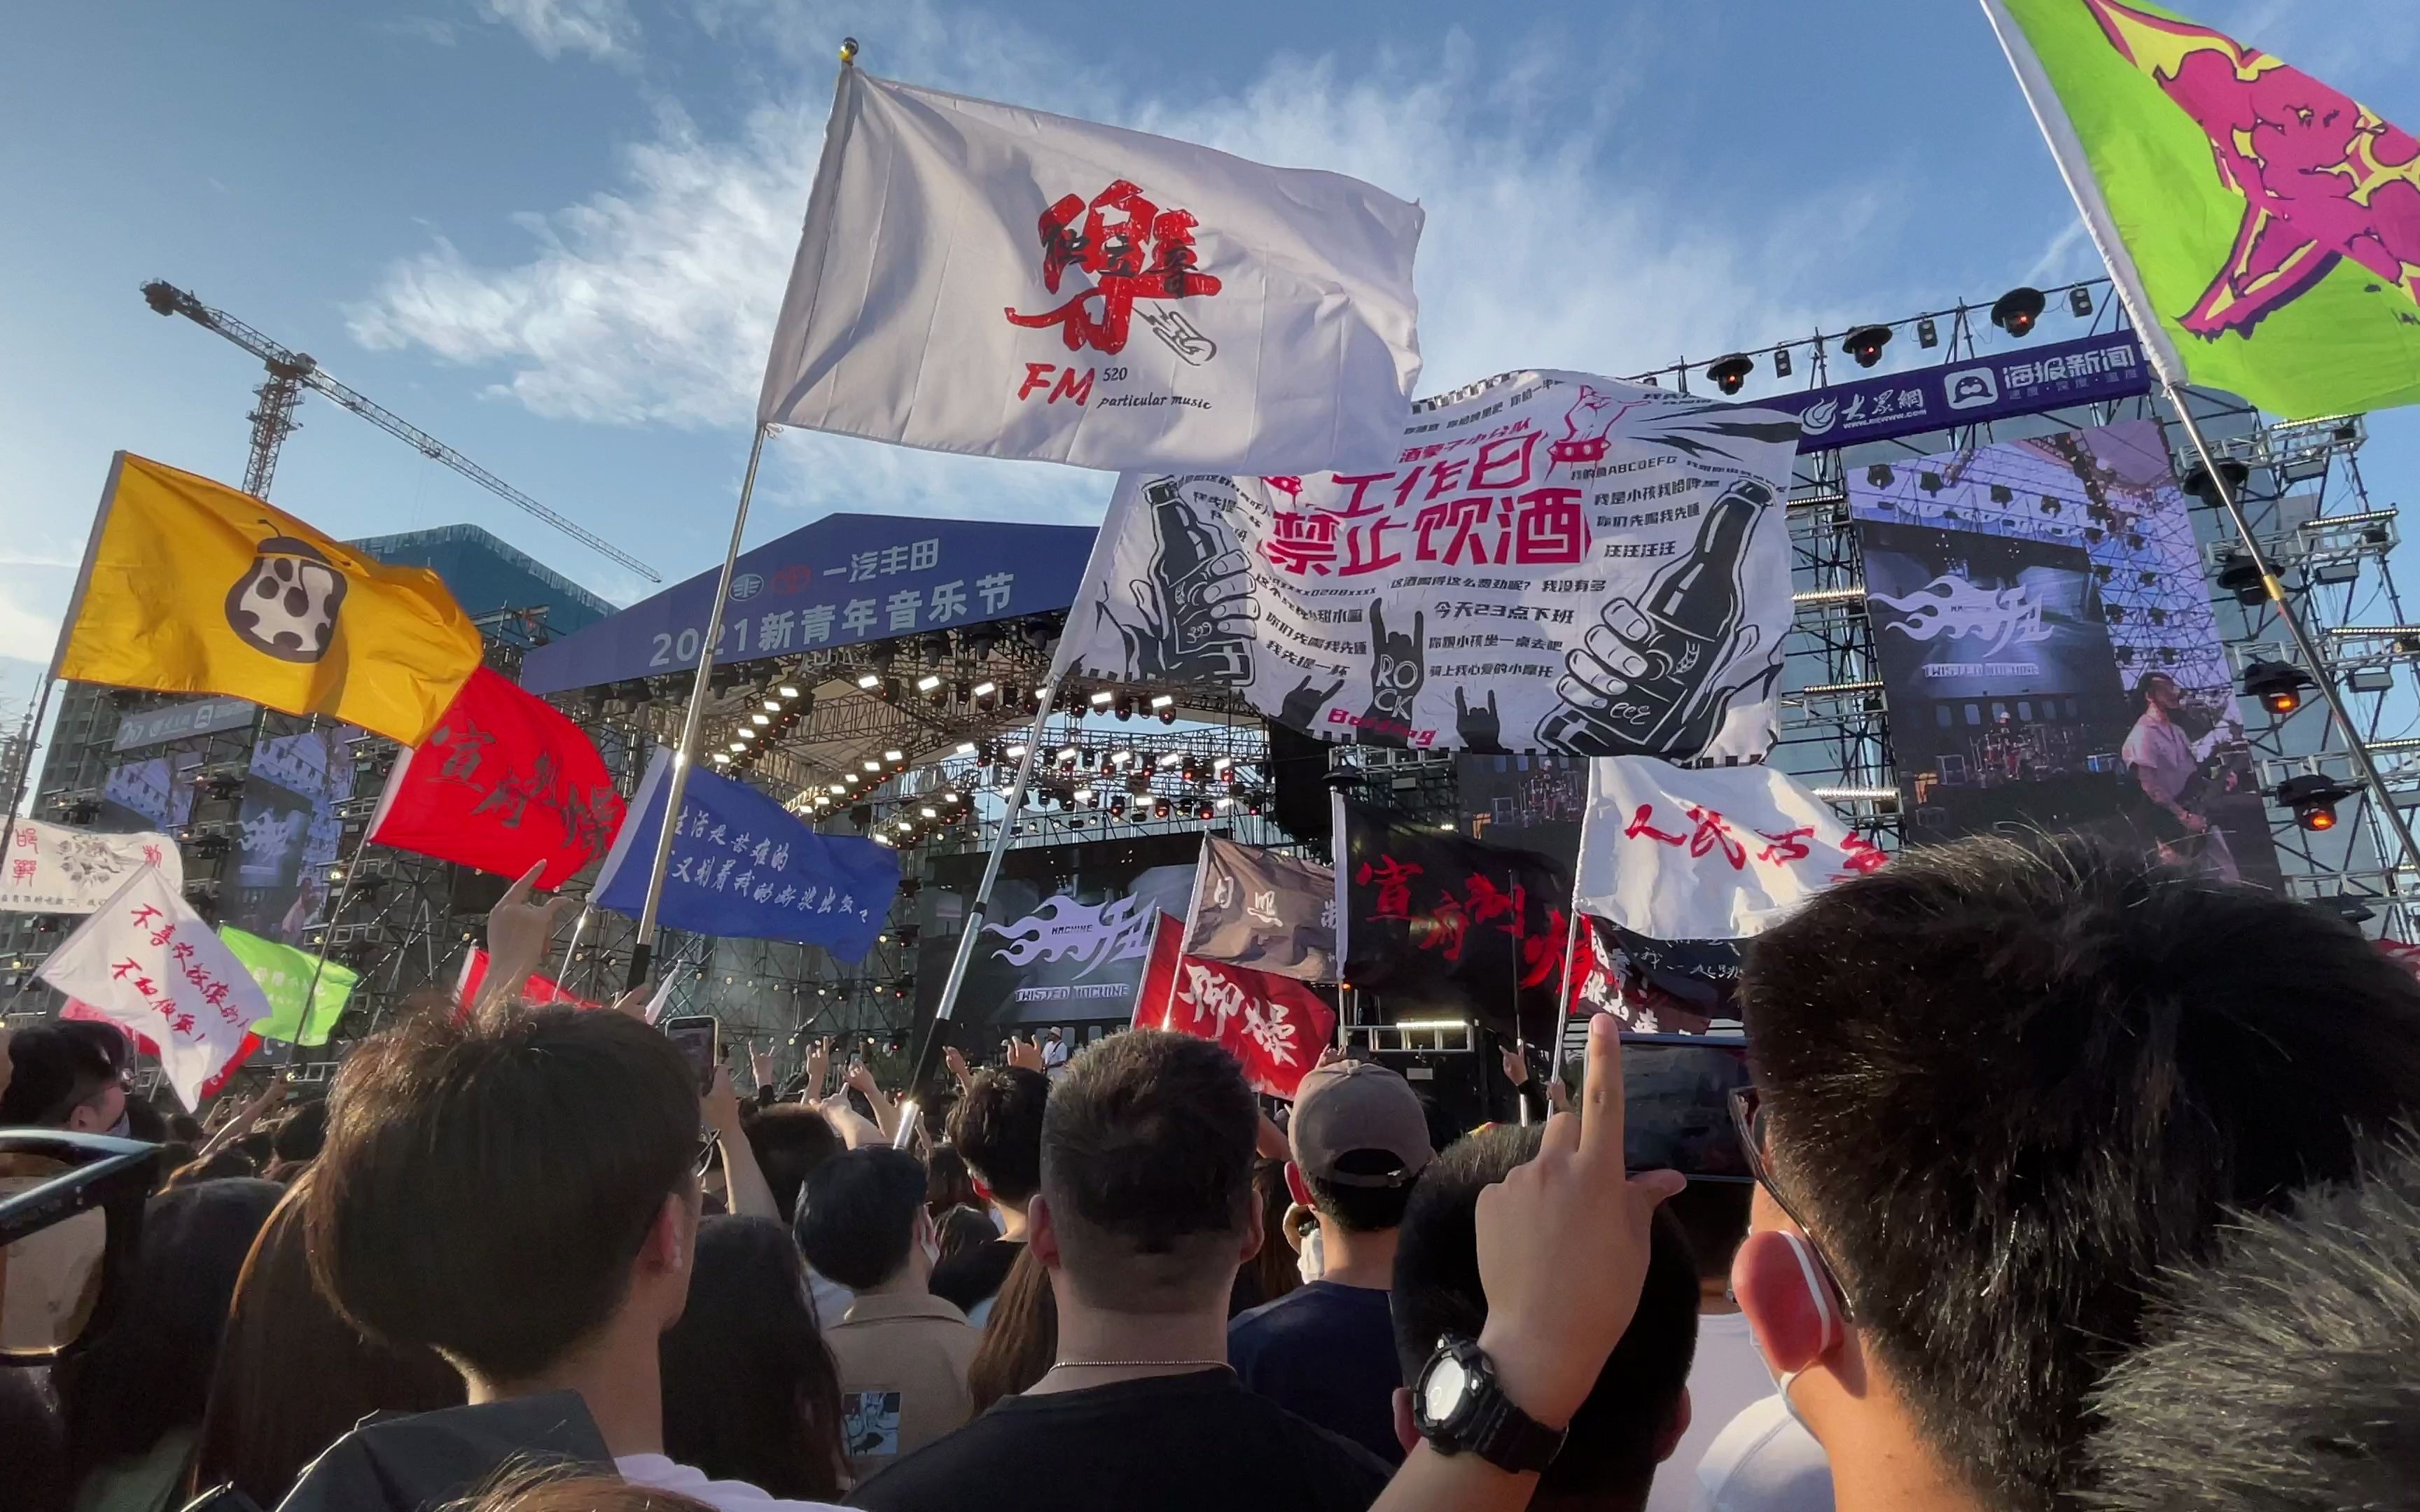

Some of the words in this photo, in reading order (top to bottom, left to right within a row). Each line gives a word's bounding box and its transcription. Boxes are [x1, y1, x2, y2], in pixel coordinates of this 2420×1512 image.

[1103, 368, 1128, 382] 520
[2003, 344, 2136, 389] 海报新闻
[1017, 363, 1095, 406] FM
[1097, 392, 1167, 409] particular
[1171, 393, 1212, 410] music
[1307, 429, 1543, 519] 工作日
[1266, 487, 1584, 578] 禁止饮酒
[1604, 540, 1676, 558] 汪汪汪汪
[823, 538, 940, 584] 一汽丰田
[648, 571, 1015, 668] 2021新青年音乐节
[1434, 601, 1575, 624] 今天23点下班
[1428, 662, 1555, 678] 骑上我心爱的小摩托
[1015, 986, 1069, 1002] TWISTED
